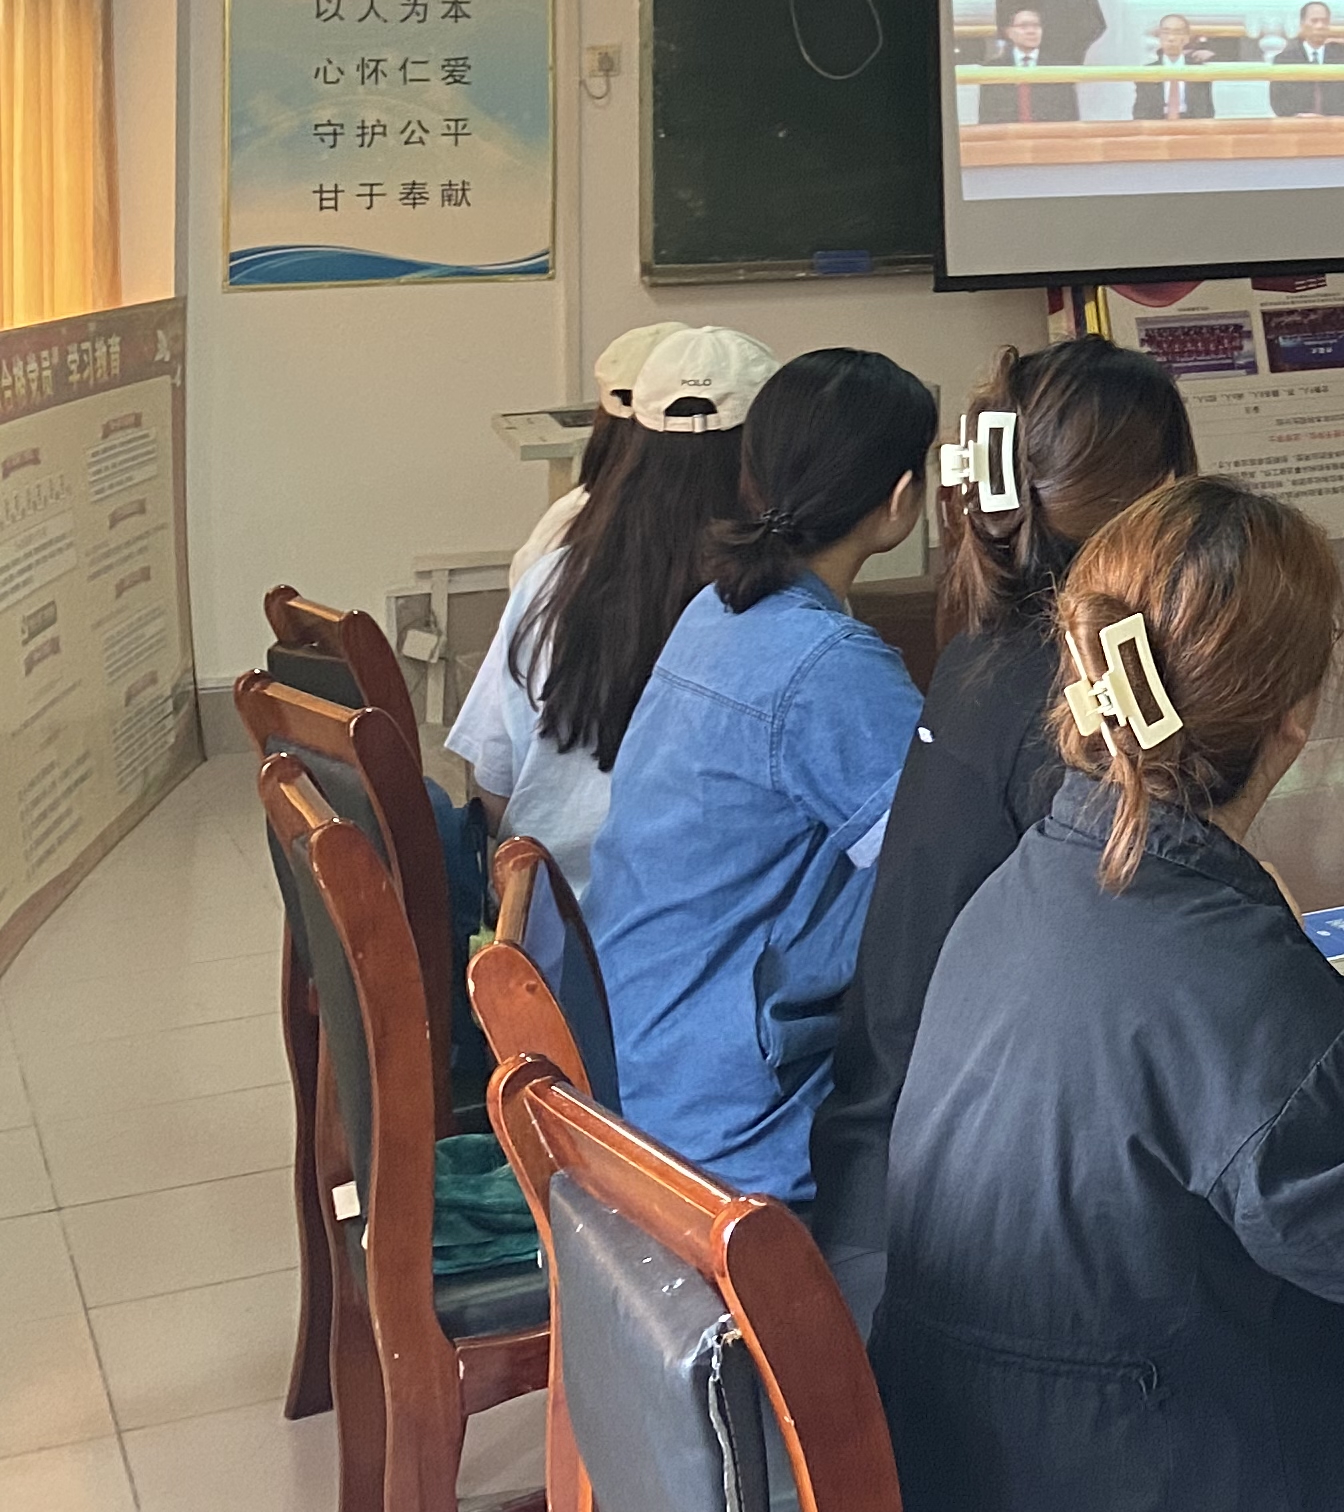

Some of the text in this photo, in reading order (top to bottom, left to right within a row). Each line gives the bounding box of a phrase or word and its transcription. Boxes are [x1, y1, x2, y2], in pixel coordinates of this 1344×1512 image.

[313, 56, 472, 86] 心怀仁爱
[312, 118, 472, 148] 守护公平
[312, 180, 472, 212] 甘于奉献
